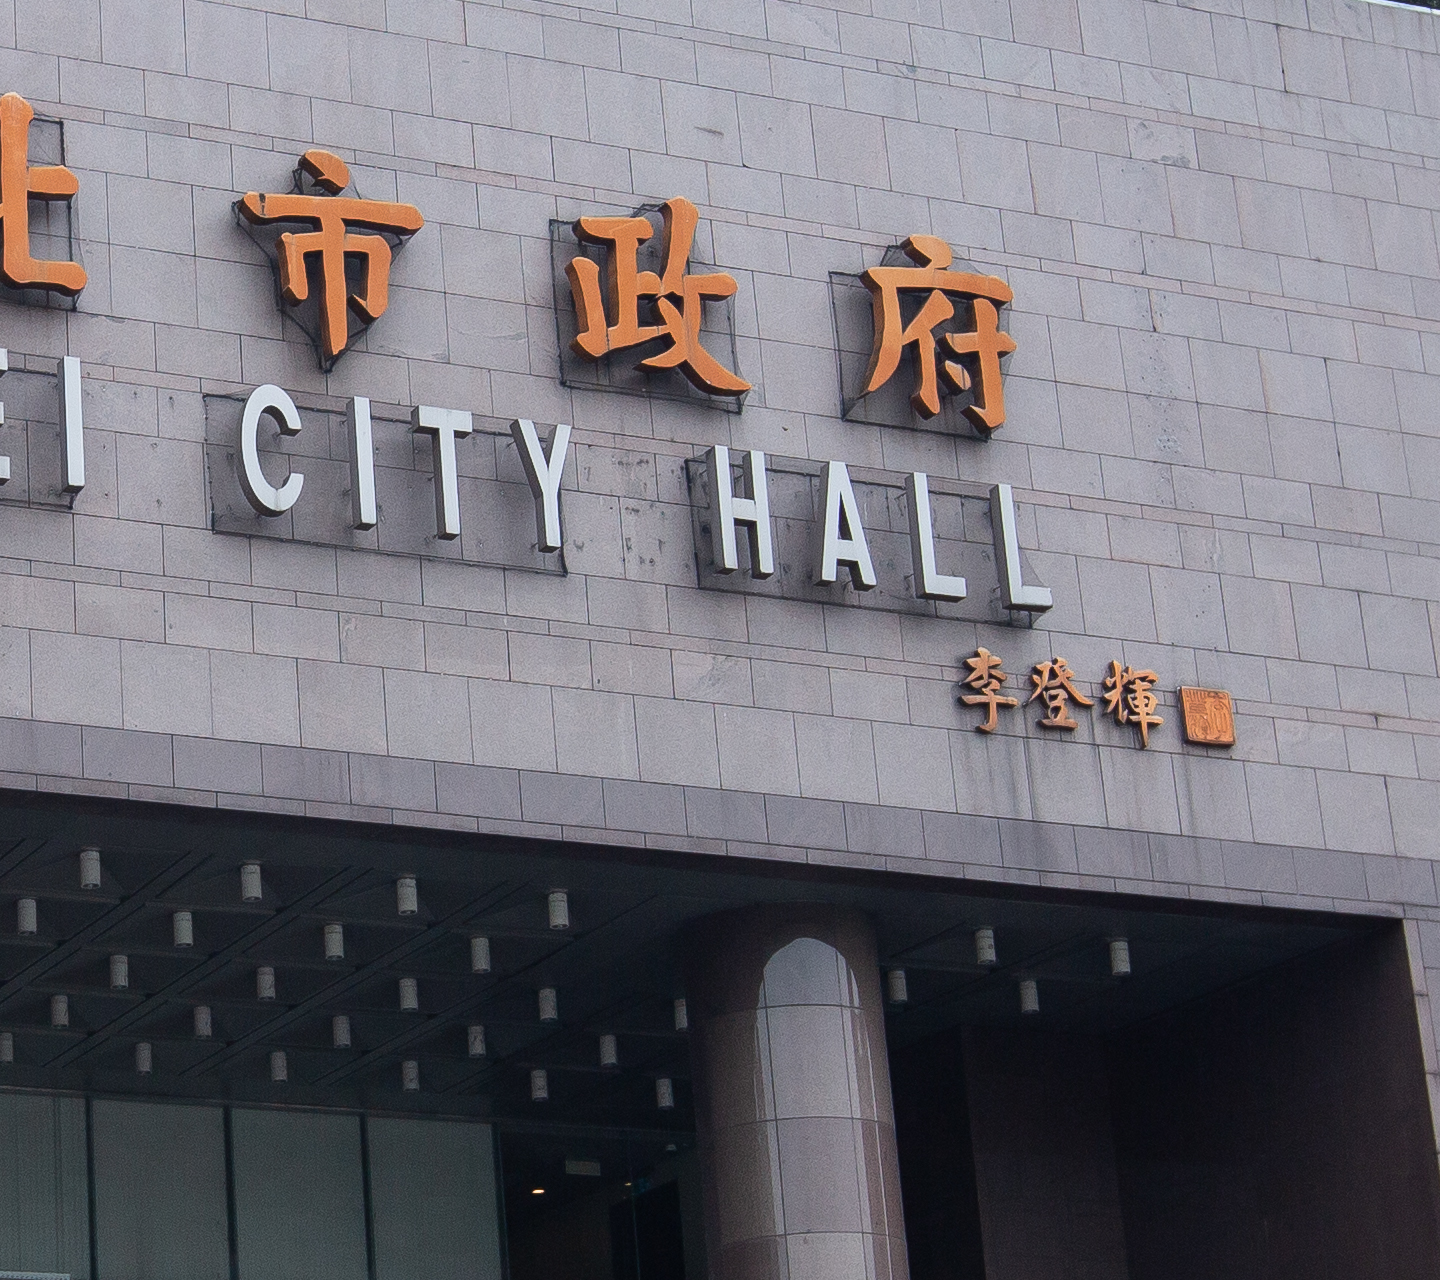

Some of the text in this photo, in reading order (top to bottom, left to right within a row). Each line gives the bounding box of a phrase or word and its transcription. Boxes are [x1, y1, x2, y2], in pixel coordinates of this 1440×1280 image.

[235, 382, 572, 553] CITY
[705, 443, 1054, 613] HALL
[958, 646, 1166, 750] 李登輝
